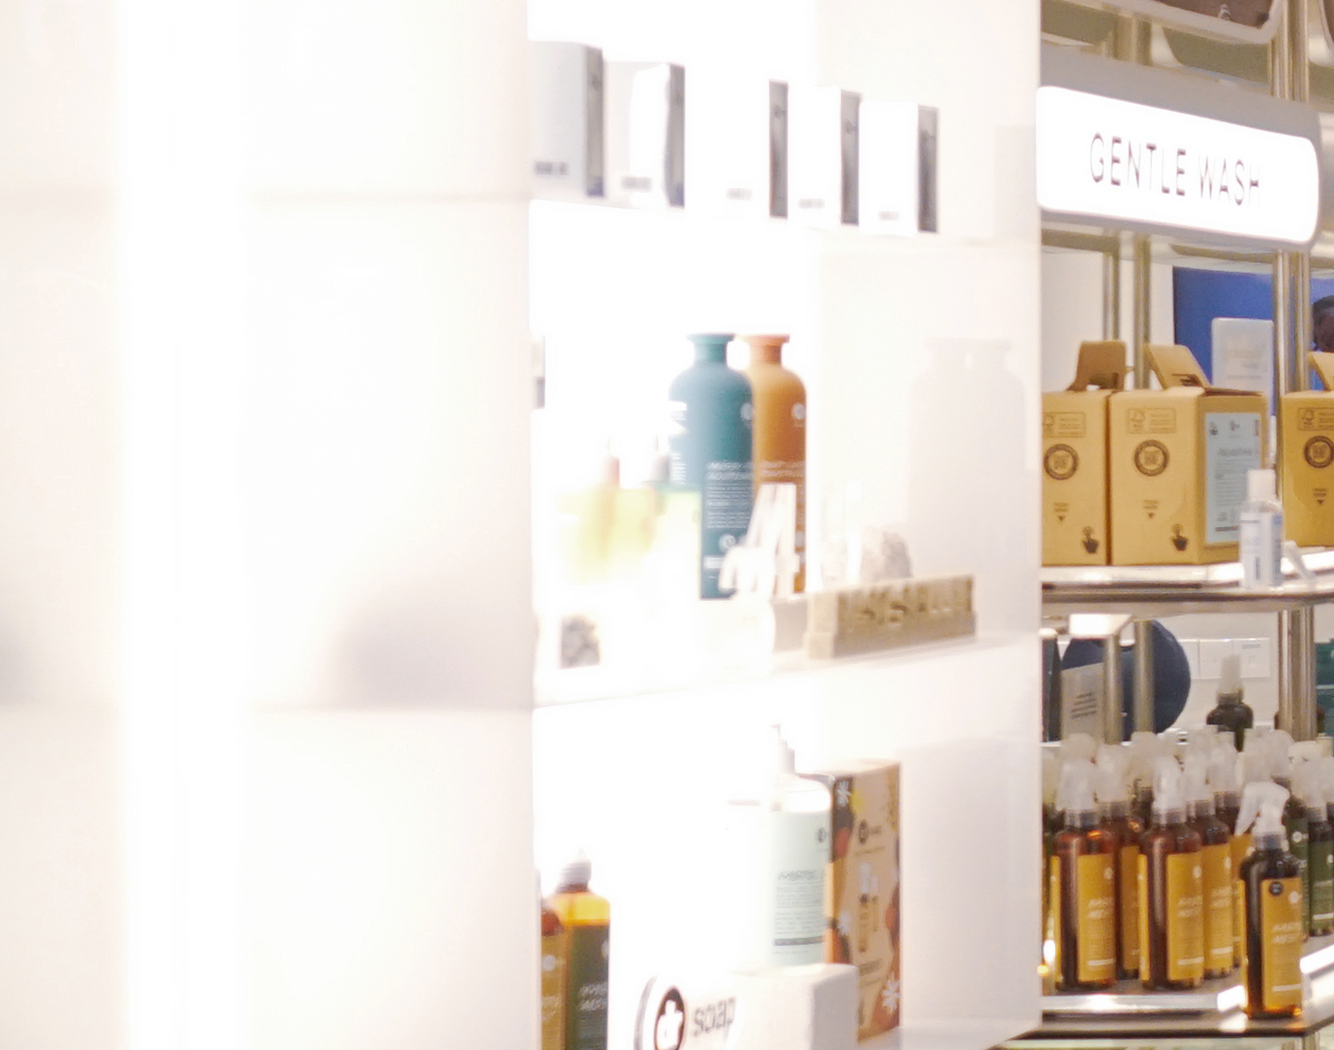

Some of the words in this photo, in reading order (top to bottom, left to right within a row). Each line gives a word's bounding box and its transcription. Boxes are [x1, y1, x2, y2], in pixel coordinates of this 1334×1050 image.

[1089, 131, 1187, 197] GENTLE
[1198, 155, 1261, 207] WASH
[693, 996, 737, 1041] soap
